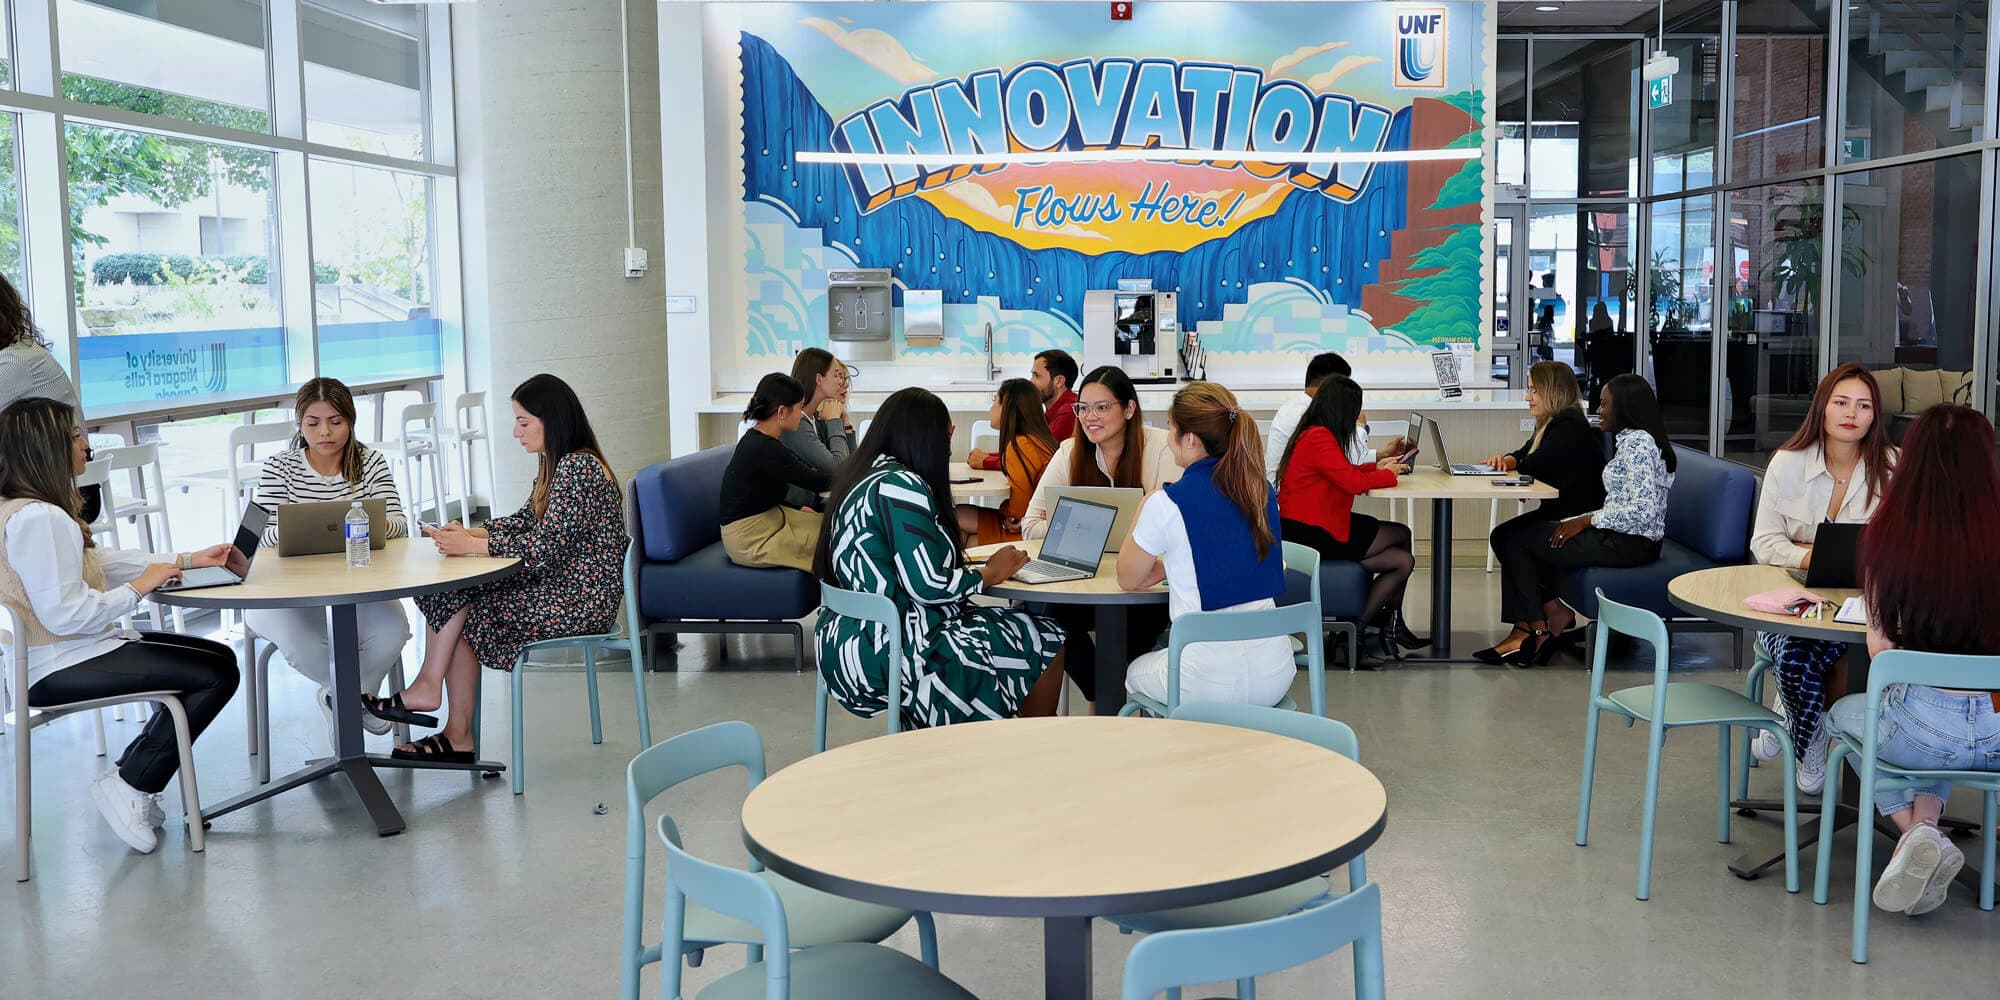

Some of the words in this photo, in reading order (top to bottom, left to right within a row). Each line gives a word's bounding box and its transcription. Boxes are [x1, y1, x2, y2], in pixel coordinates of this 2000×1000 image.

[1399, 15, 1441, 34] UNF
[833, 59, 1394, 213] INNOVATION
[1014, 185, 1121, 228] Flows
[1130, 181, 1245, 228] Here!
